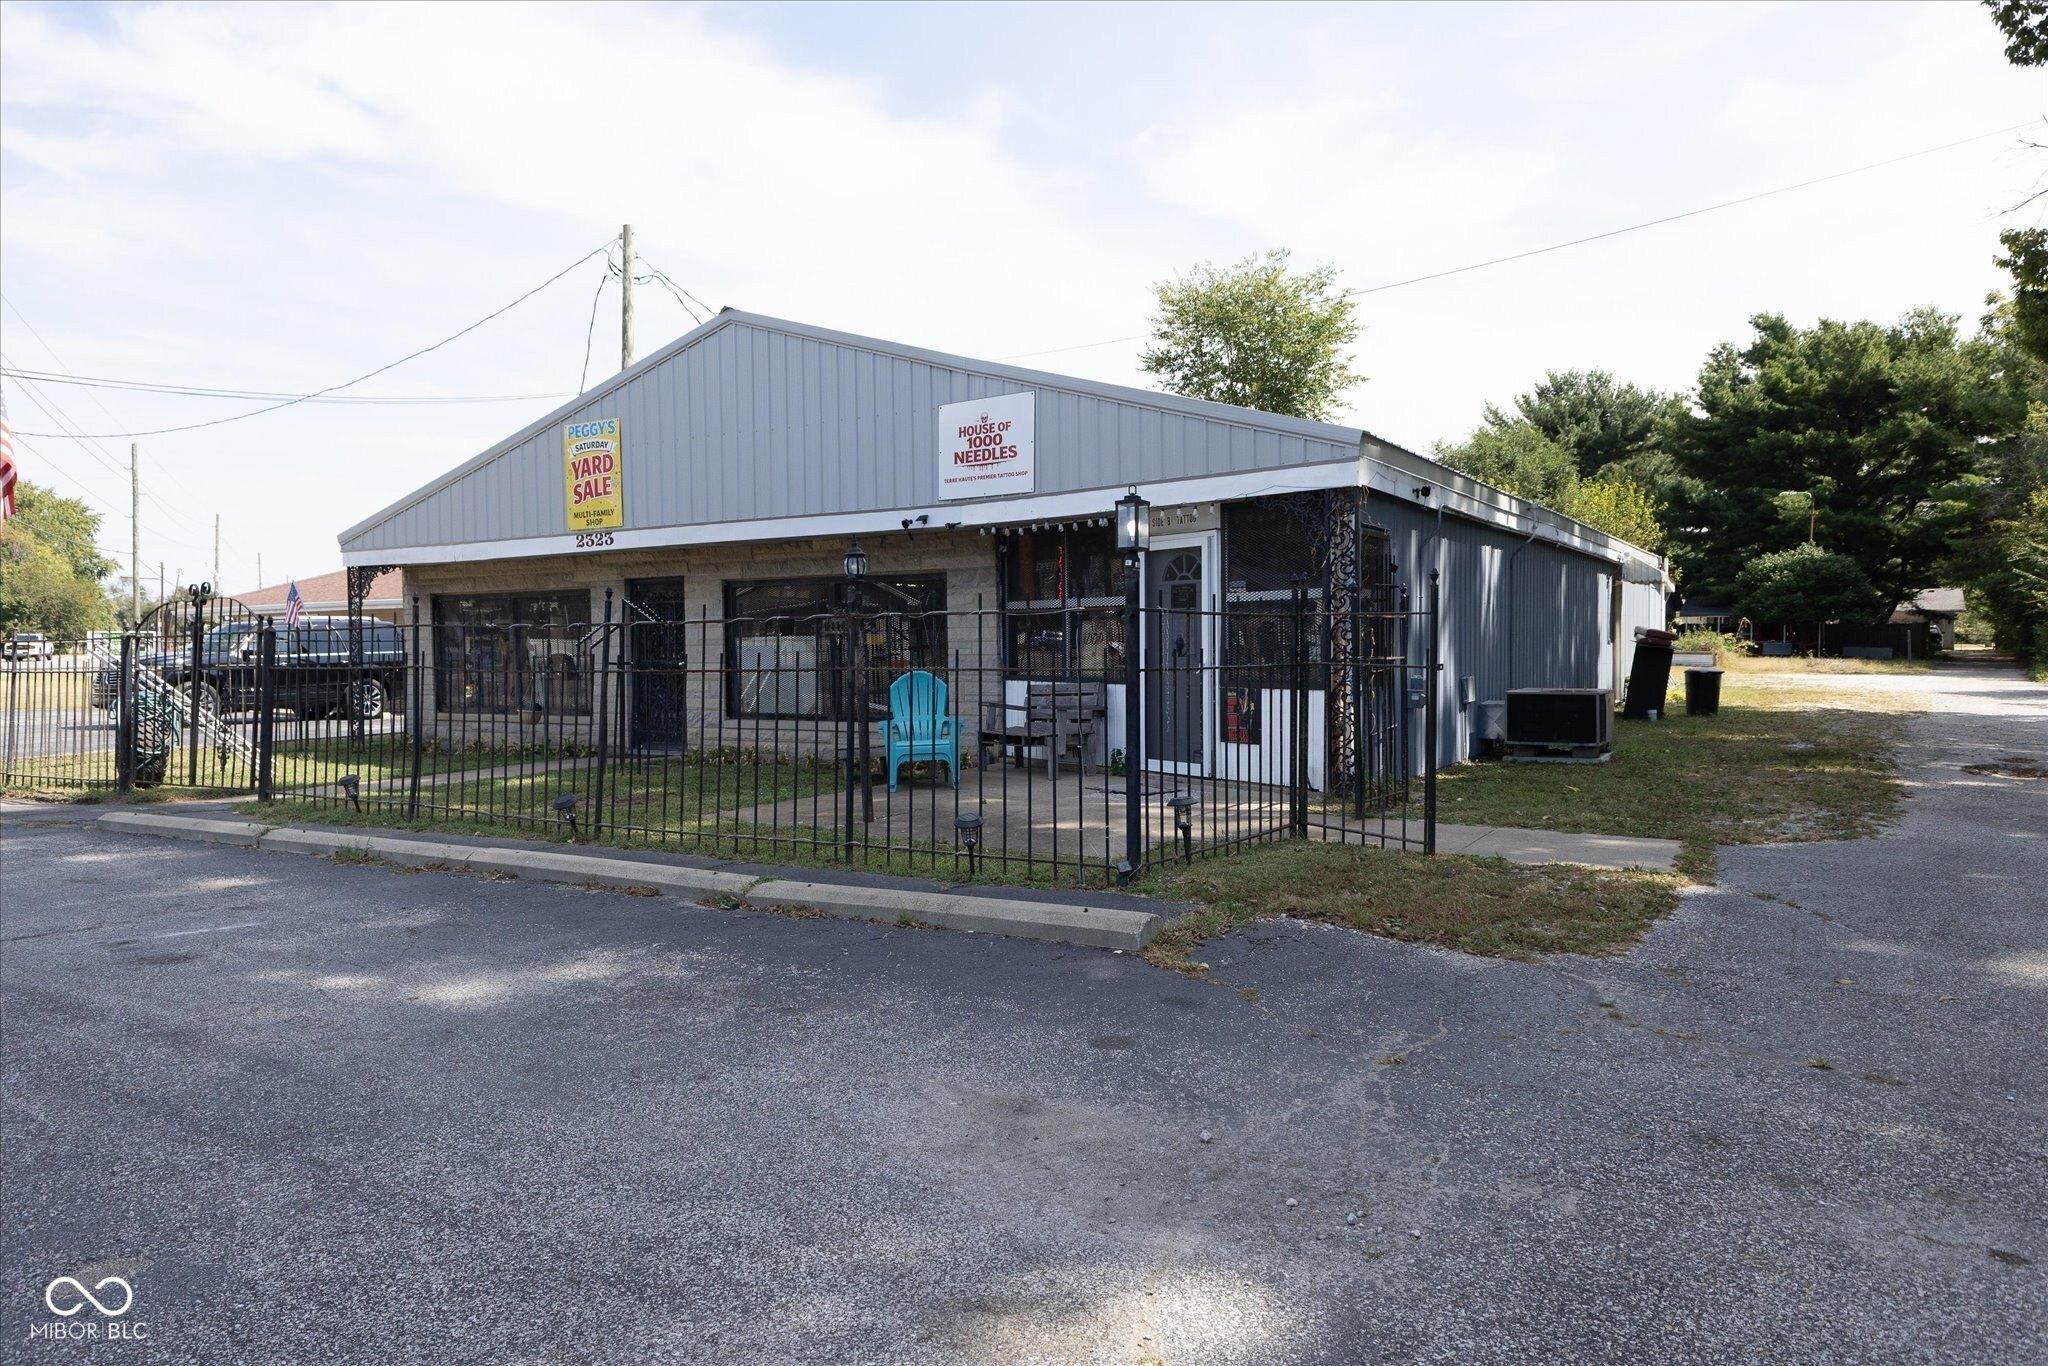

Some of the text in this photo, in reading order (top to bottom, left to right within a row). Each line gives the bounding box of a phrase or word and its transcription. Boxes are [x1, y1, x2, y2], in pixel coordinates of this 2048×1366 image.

[568, 420, 616, 439] PEGGY'S
[958, 421, 1012, 438] HOUSE OF
[575, 441, 609, 452] SATURDAY
[966, 433, 1003, 449] 1000
[953, 445, 1018, 465] NEEDLES
[570, 454, 614, 480] YARD
[977, 473, 996, 481] PREMIER
[573, 476, 612, 505] SALE
[573, 508, 615, 519] MULTI-FAMILY
[585, 518, 603, 526] SHOP
[575, 532, 614, 548] 2323
